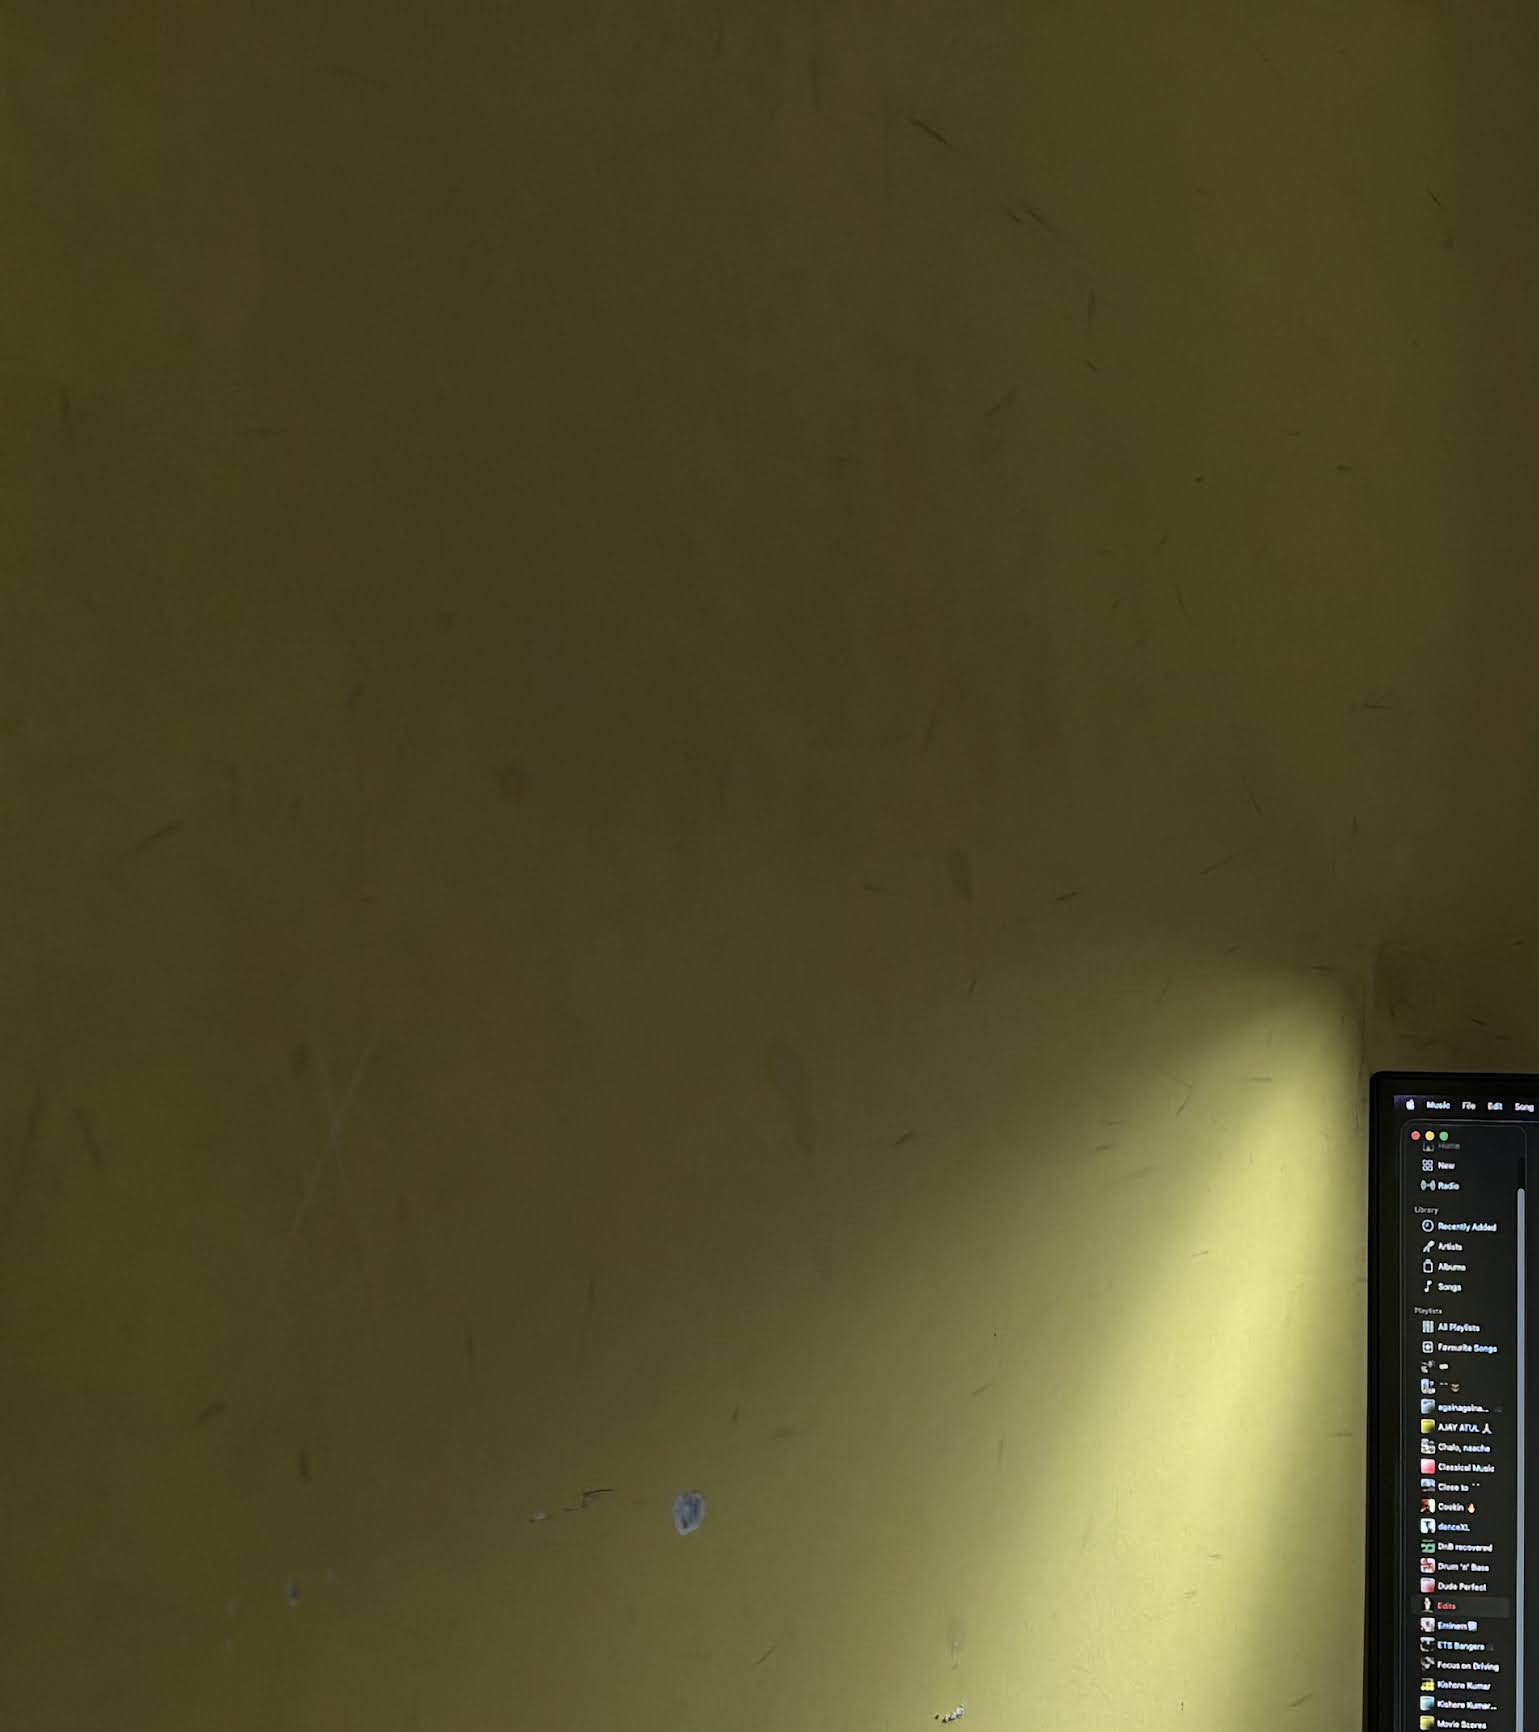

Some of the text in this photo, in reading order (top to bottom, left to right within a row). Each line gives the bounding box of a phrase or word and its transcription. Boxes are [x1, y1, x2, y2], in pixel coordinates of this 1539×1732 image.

[1427, 1101, 1450, 1109] Music
[1462, 1102, 1476, 1110] File
[1488, 1102, 1503, 1110] Edit
[1515, 1103, 1534, 1112] Song
[1438, 1182, 1459, 1190] Radio
[1414, 1206, 1438, 1215] Library
[1438, 1222, 1496, 1232] Recently Added
[1438, 1263, 1466, 1271] Albums
[1438, 1283, 1461, 1292] Songs
[1415, 1307, 1442, 1315] Playlists
[1449, 1323, 1480, 1332] Playlists
[1438, 1343, 1497, 1354] Favourite Songs
[1438, 1463, 1494, 1472] Classical Music
[1438, 1503, 1464, 1511] Cookin
[1438, 1582, 1486, 1591] Dude Perfect
[1437, 1661, 1460, 1669] Focus
[1473, 1662, 1499, 1672] Driving
[1437, 1720, 1486, 1729] Movie Scores
